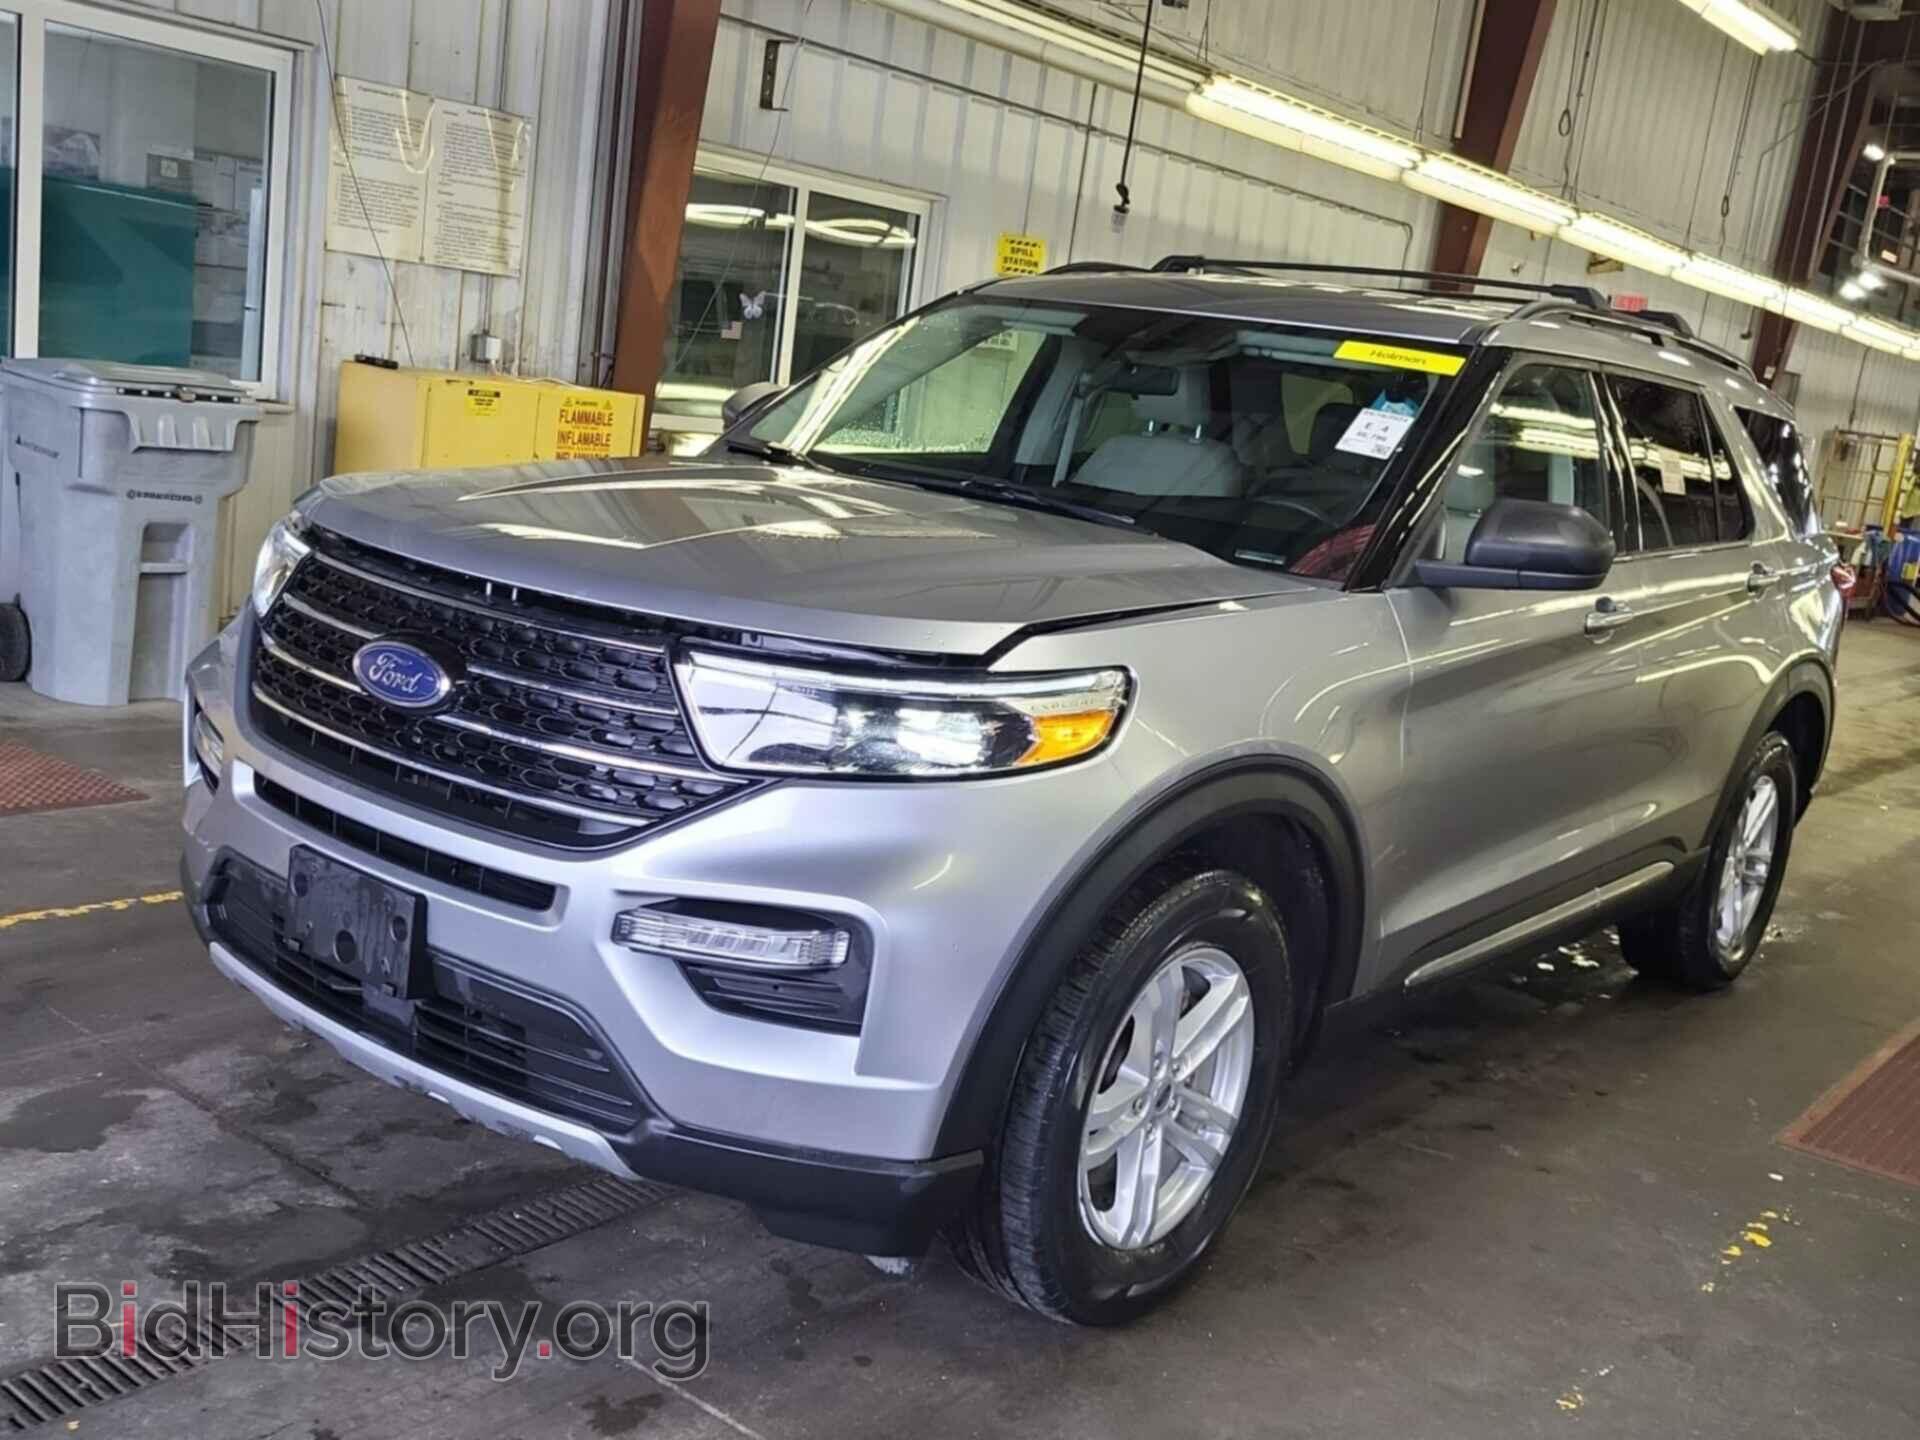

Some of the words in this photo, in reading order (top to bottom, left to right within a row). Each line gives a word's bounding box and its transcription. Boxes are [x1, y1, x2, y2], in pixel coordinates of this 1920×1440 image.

[1003, 256, 1039, 268] STATION
[559, 408, 614, 426] FLAMMABLE
[556, 430, 611, 447] INFLAMABLE
[369, 652, 423, 693] Ford
